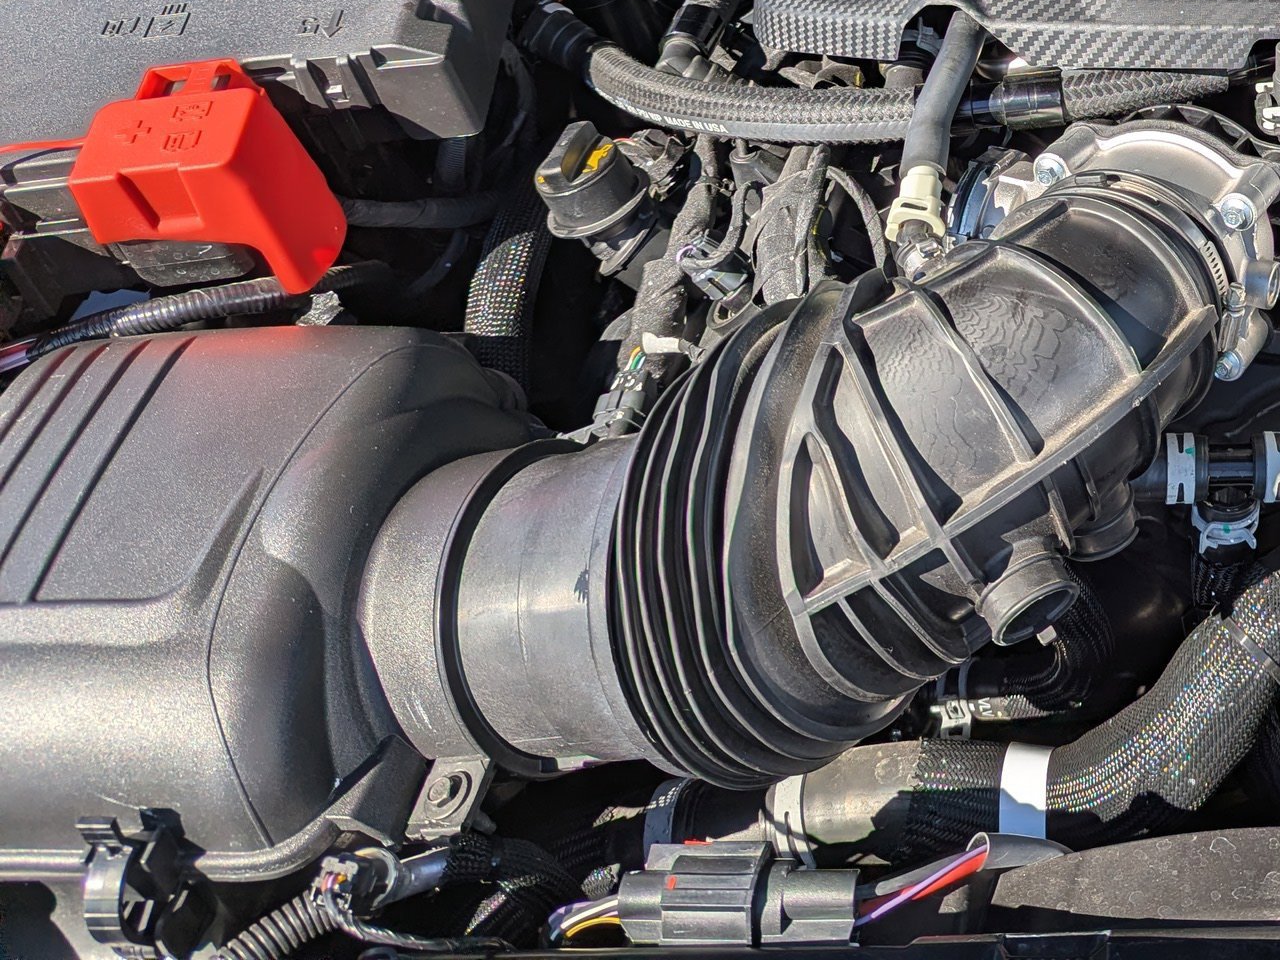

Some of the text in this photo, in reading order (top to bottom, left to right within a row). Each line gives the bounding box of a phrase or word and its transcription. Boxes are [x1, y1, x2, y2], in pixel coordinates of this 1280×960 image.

[663, 115, 693, 129] MADE
[693, 121, 704, 131] IN
[705, 122, 729, 134] USA
